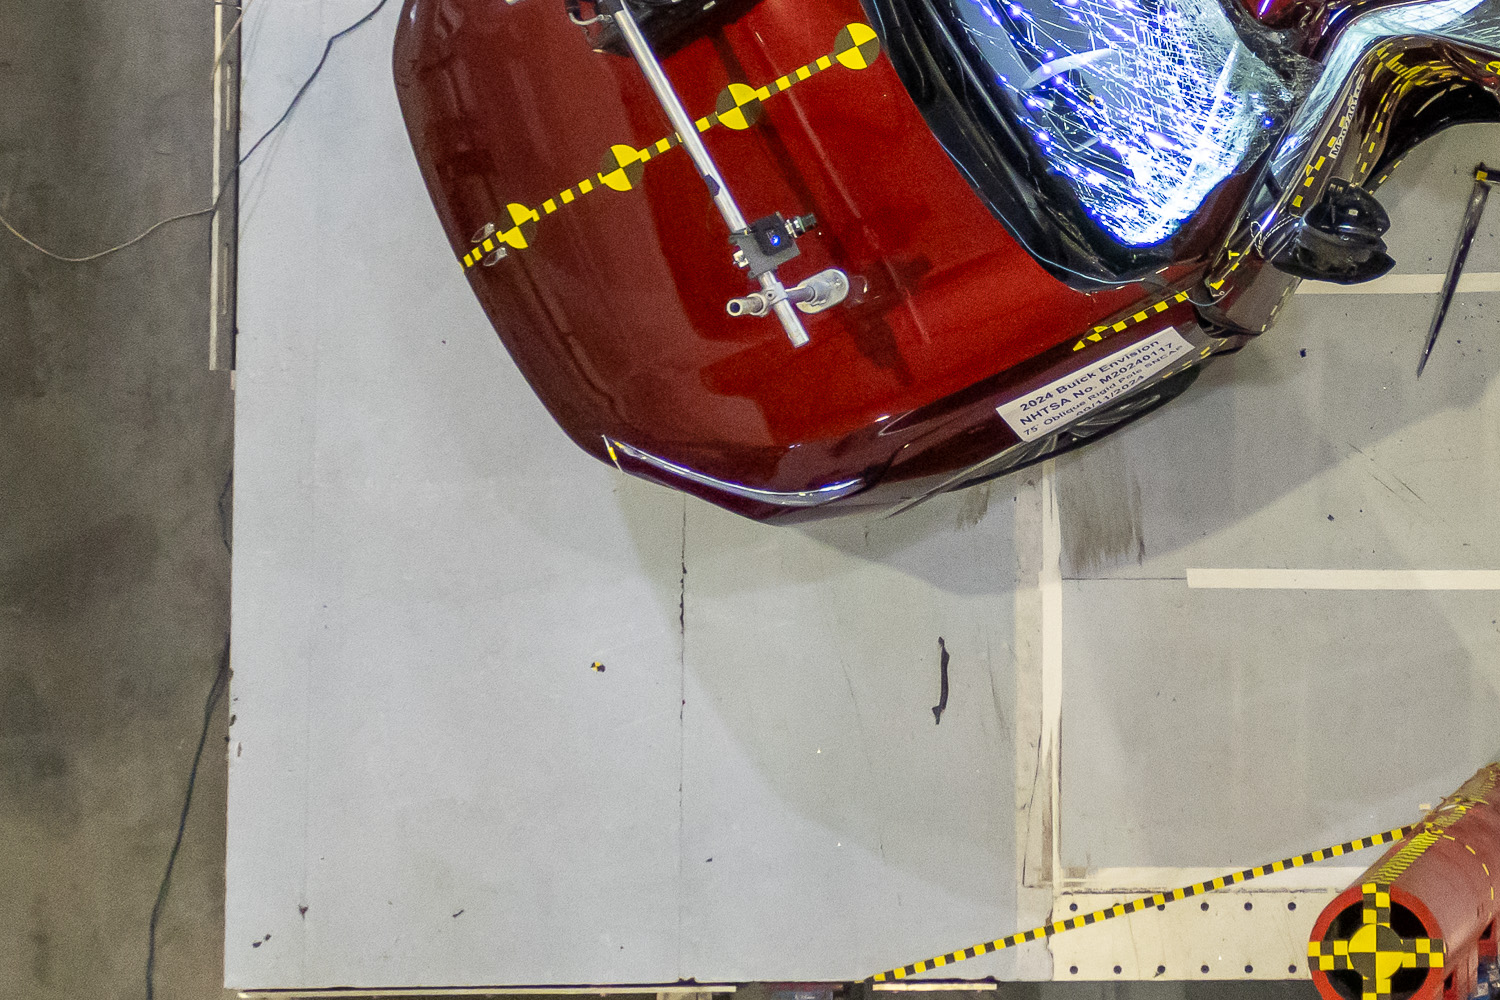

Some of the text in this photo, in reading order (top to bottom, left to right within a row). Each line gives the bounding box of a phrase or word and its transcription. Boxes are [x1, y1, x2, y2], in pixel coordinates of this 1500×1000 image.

[1020, 340, 1160, 412] 2024 Buick Envision
[1020, 342, 1173, 425] NHTSA No. M20240117
[1043, 400, 1087, 425] Oblique
[1088, 383, 1117, 401] Rigid
[1118, 368, 1143, 384] Pole
